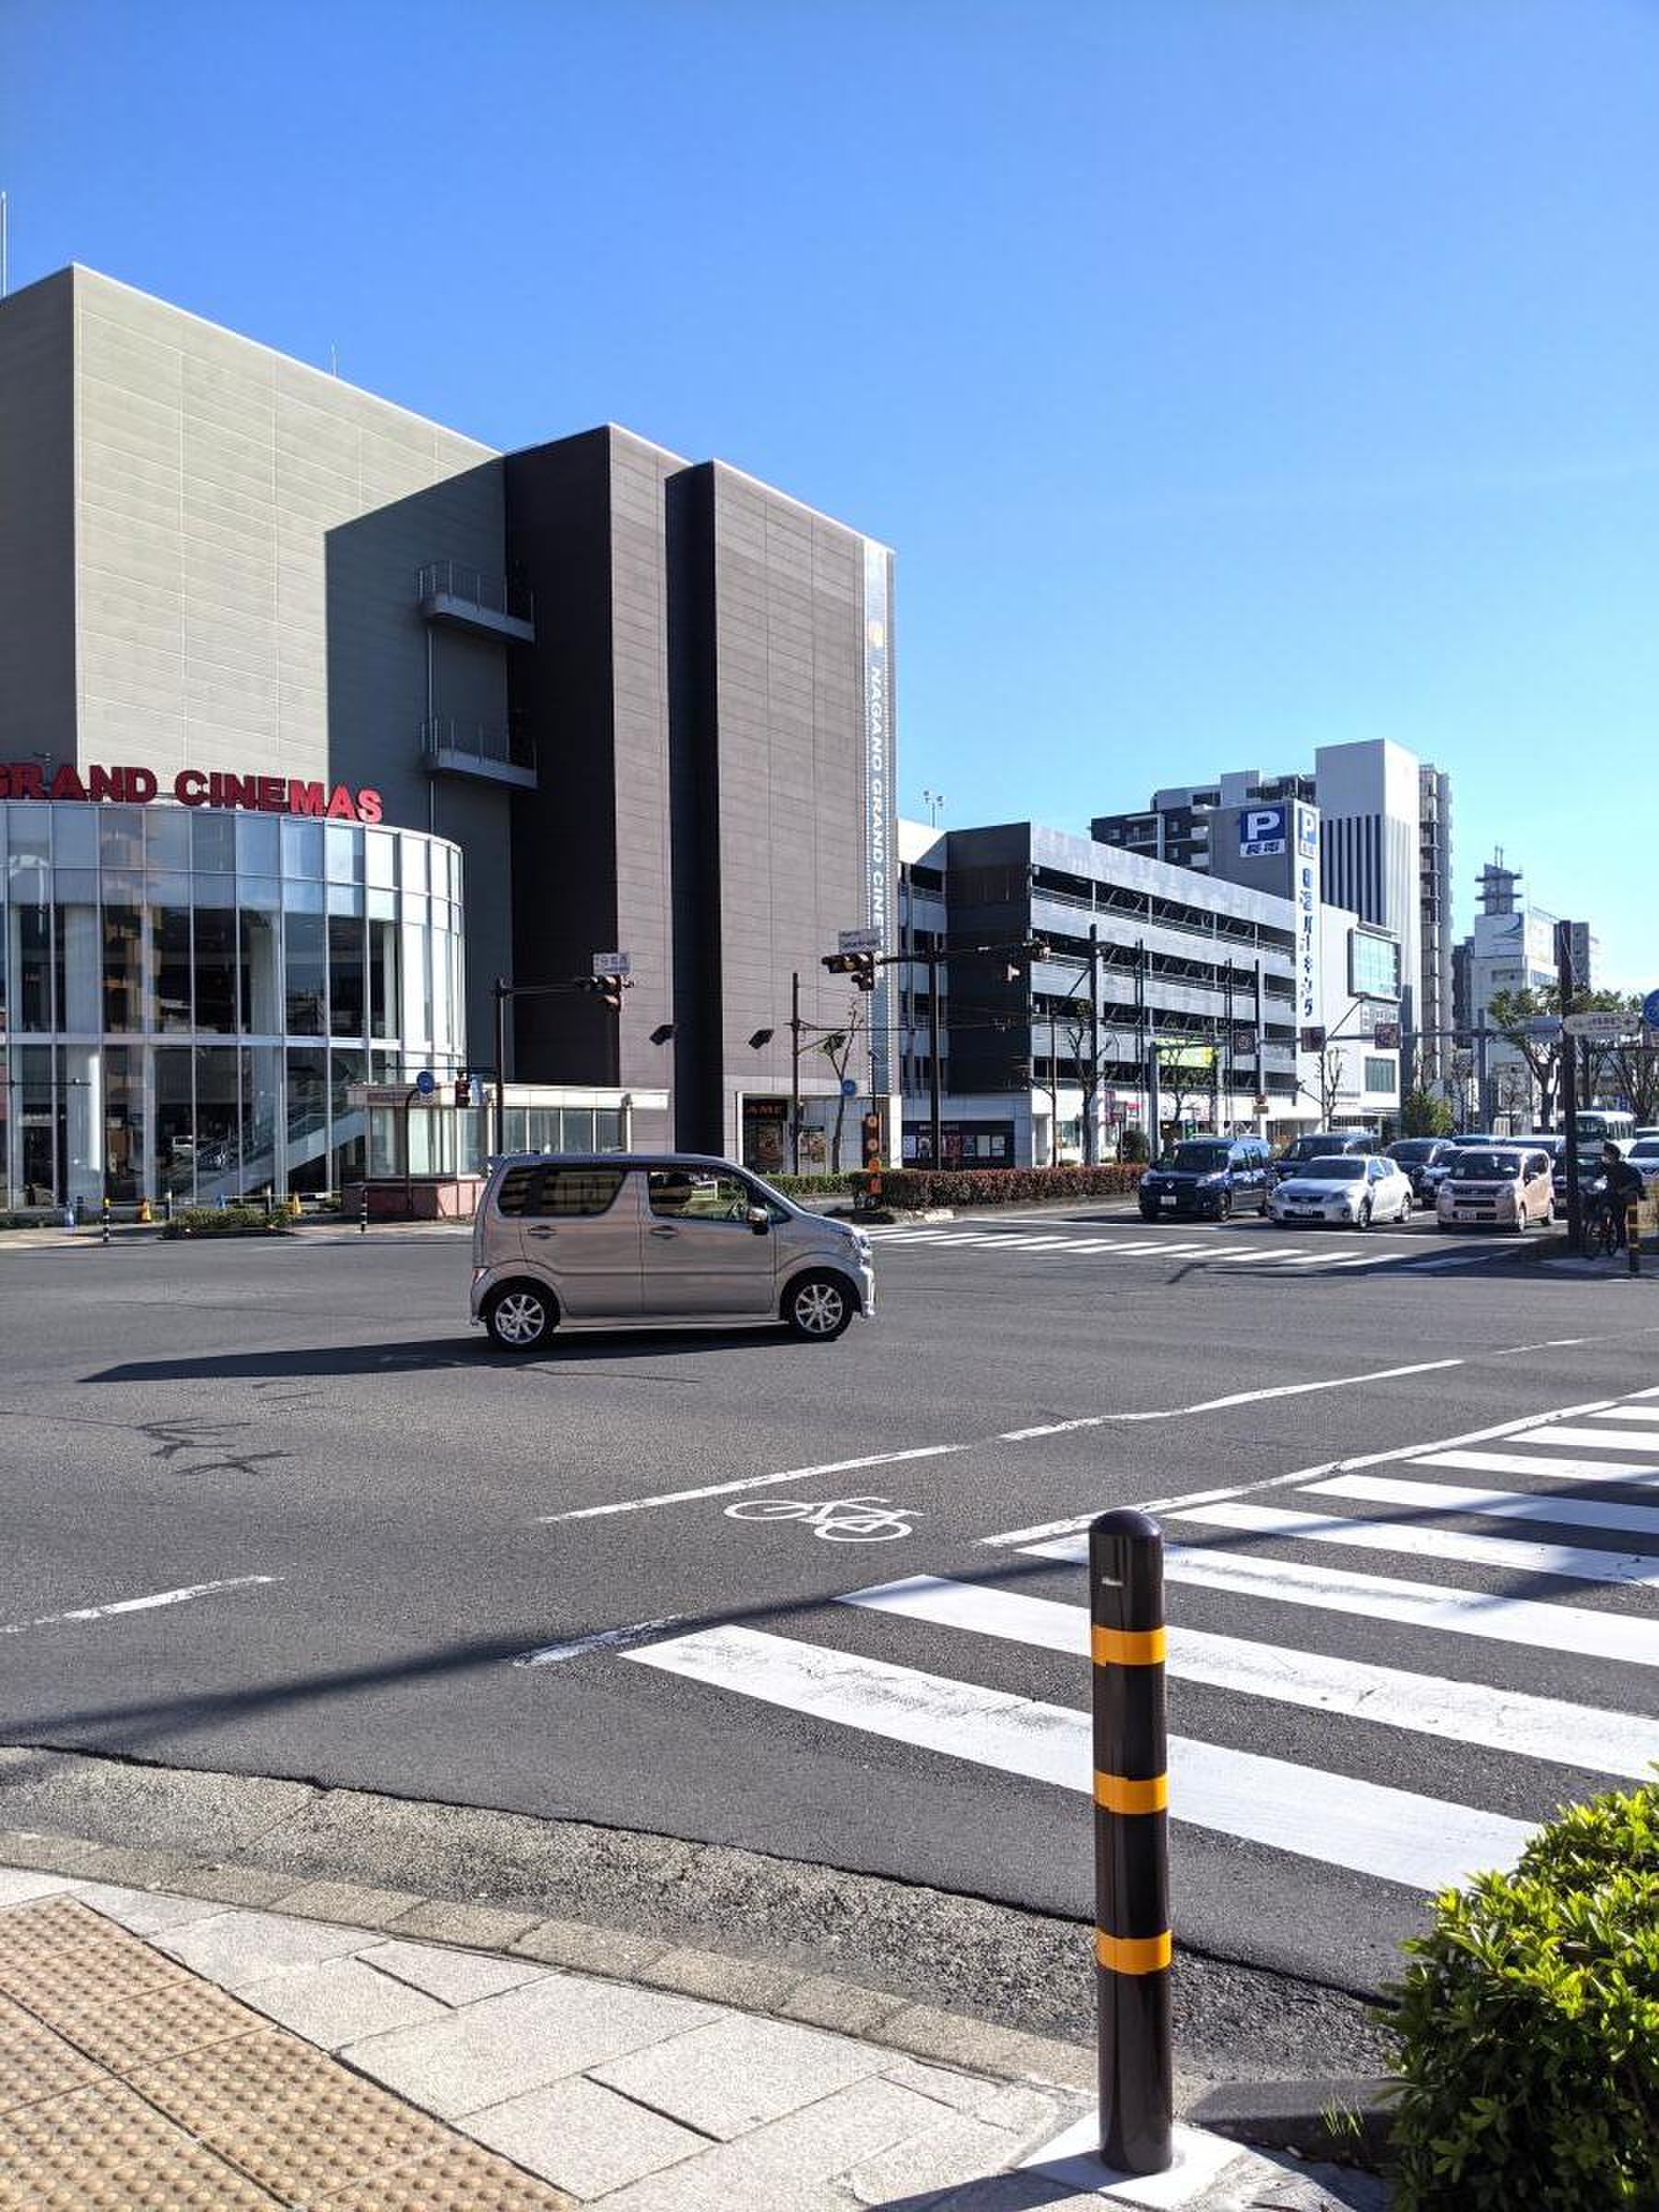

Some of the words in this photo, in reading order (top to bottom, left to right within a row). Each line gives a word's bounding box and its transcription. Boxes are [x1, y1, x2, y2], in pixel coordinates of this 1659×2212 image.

[870, 665, 883, 772] NAGANO
[0, 764, 159, 803] RAND
[174, 769, 384, 824] CINEMAS
[872, 779, 885, 864] GRAND
[1247, 810, 1280, 841] P
[872, 870, 885, 979] CINEAS
